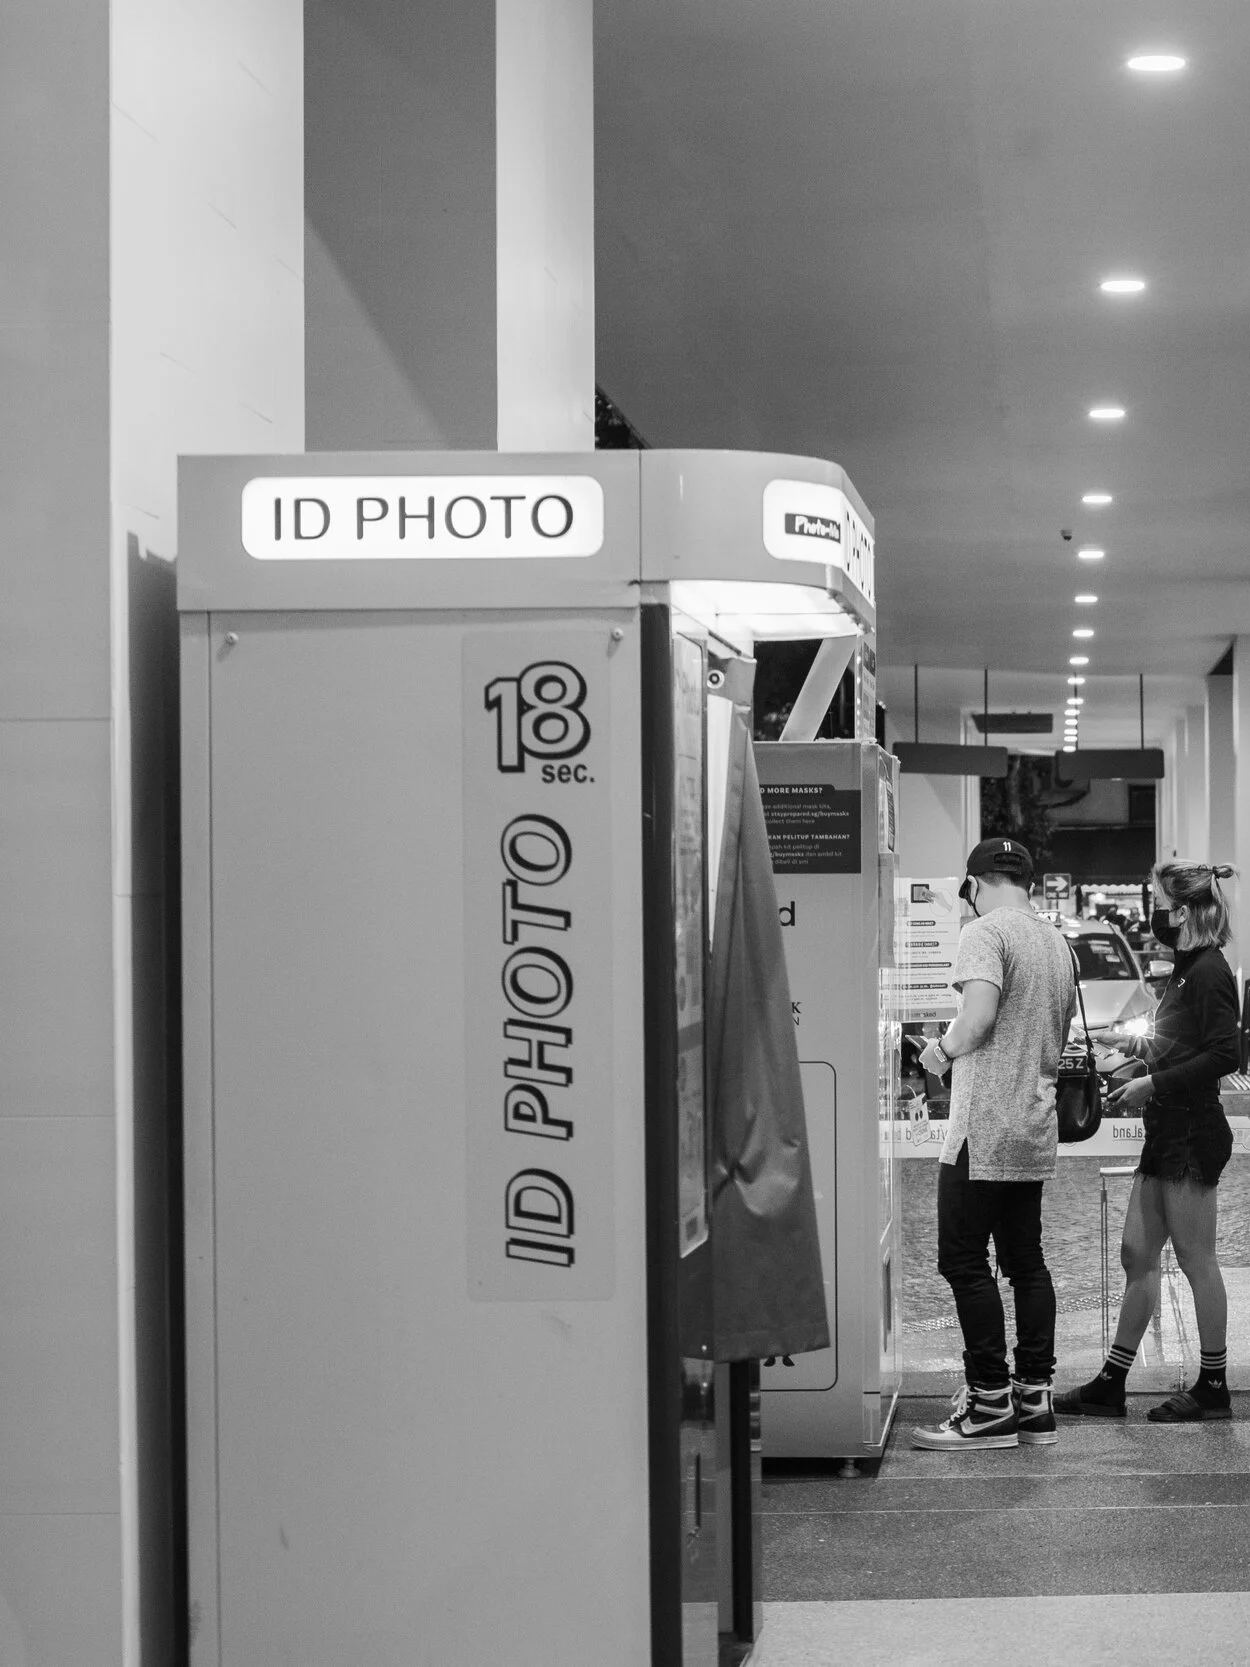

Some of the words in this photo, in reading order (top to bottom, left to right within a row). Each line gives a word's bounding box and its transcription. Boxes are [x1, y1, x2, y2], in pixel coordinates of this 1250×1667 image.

[275, 495, 330, 540] ID
[357, 495, 573, 540] PHOTO
[484, 660, 592, 773] 18
[541, 760, 596, 783] sec.
[502, 813, 574, 1141] PHOTO
[505, 1168, 576, 1268] ID
